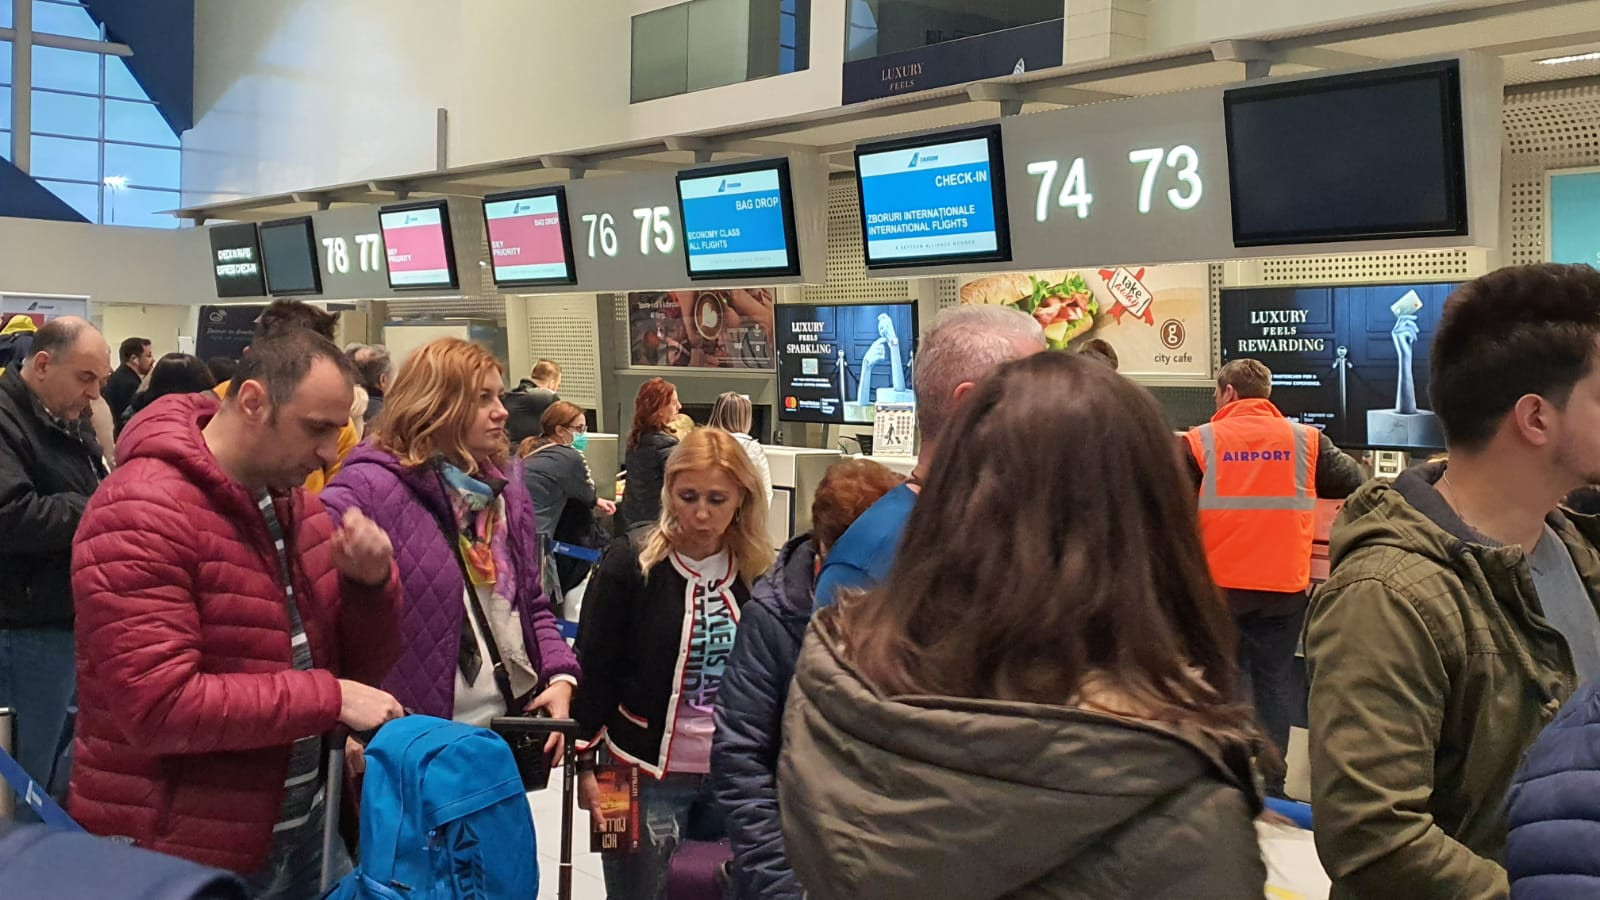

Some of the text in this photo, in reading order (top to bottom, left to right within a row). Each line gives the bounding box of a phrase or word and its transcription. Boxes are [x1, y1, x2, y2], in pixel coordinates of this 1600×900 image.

[881, 62, 923, 81] LUXURY
[889, 80, 915, 91] FEELS
[935, 170, 987, 188] CHECK-IN
[1128, 144, 1203, 214] 73
[1026, 157, 1093, 222] 74
[735, 197, 779, 211] BAG DROP
[867, 212, 902, 224] ZBORURI
[581, 213, 618, 257] 76
[632, 206, 675, 255] 75
[688, 228, 740, 240] ECONOMY CLASS
[868, 218, 968, 236] INTERNATIONAL FLIGHTS
[355, 233, 380, 272] 77
[689, 239, 728, 250] ALL FLIGHTS
[321, 237, 350, 274] 78
[1122, 275, 1142, 298] take
[1250, 309, 1308, 325] LUXURY
[791, 322, 825, 332] LUXURY
[1262, 326, 1297, 336] FEELS
[798, 334, 818, 342] FEELS
[1237, 338, 1325, 352] REWARDING
[786, 343, 832, 354] SPARKLING
[1154, 352, 1193, 365] city cafe
[1223, 450, 1291, 462] AIRPORT
[707, 579, 731, 644] STYLE
[706, 648, 730, 667] IS
